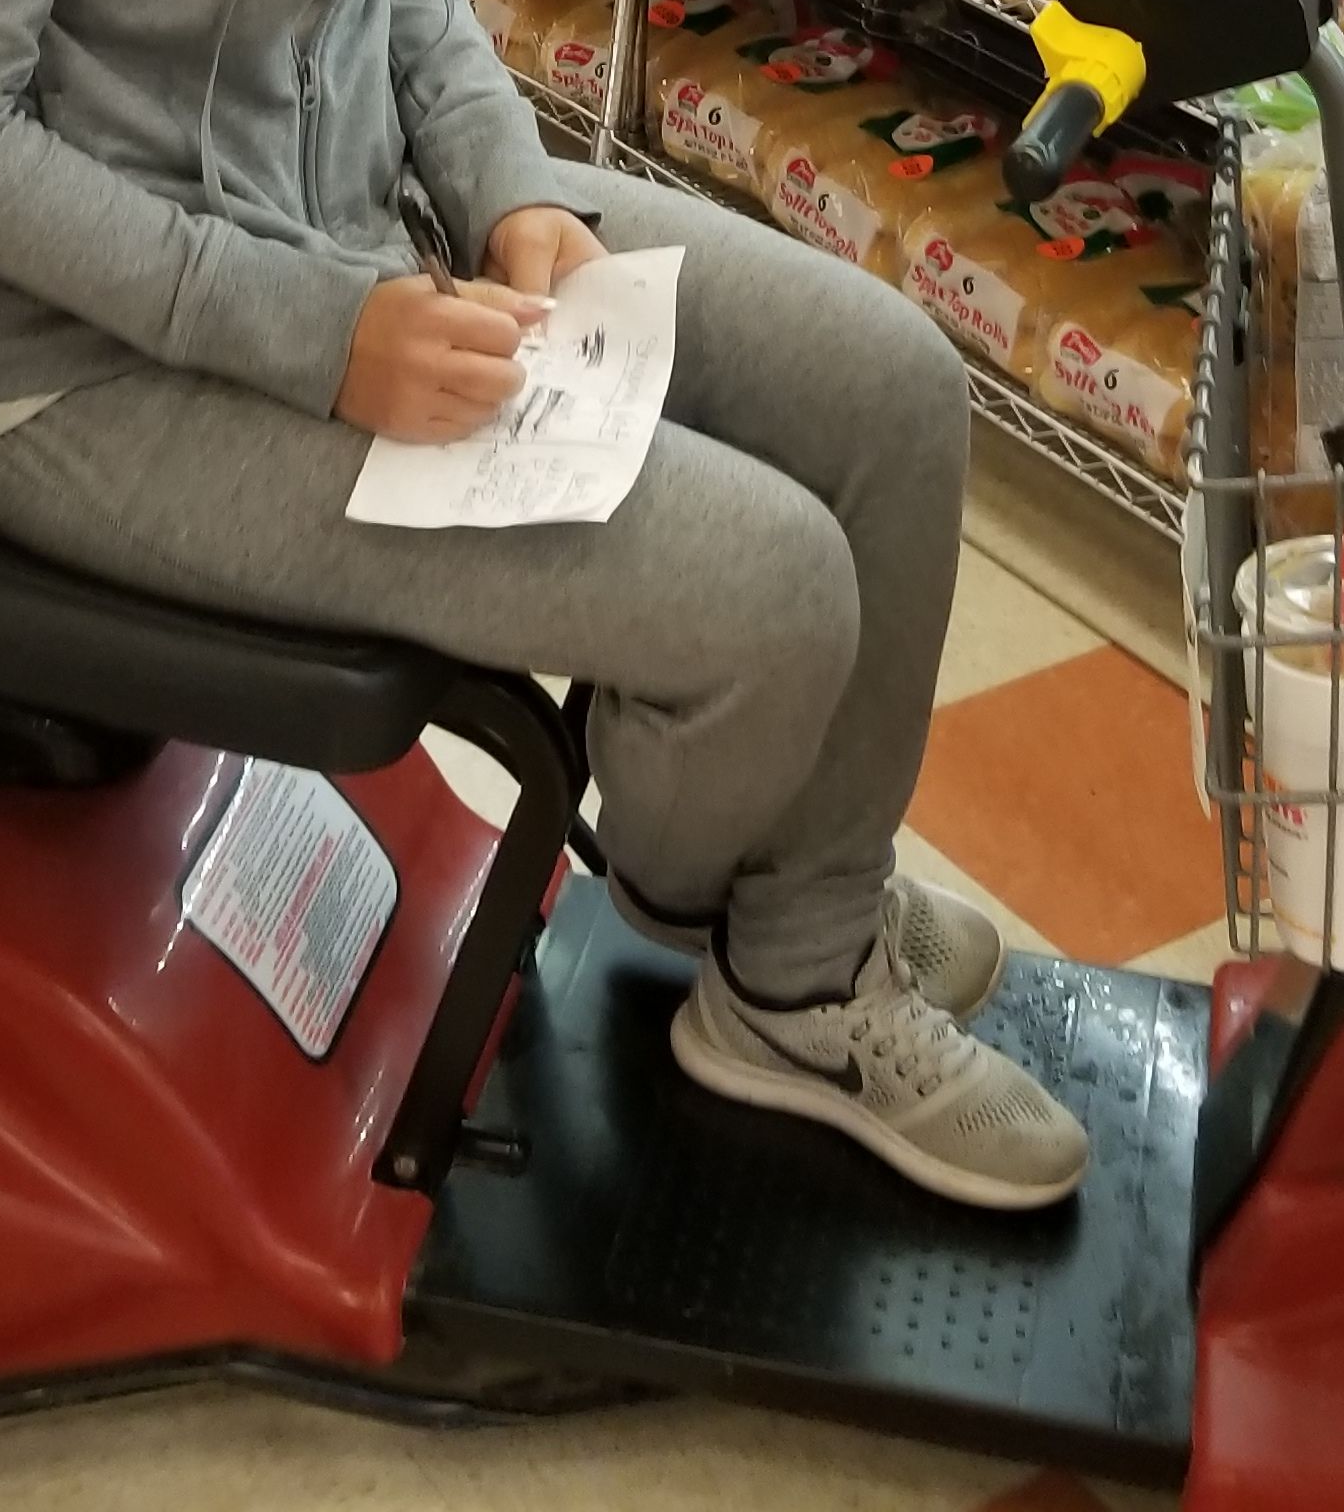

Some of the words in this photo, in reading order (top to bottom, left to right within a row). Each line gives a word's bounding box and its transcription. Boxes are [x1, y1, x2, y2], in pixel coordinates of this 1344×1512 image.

[595, 62, 608, 79] 6
[708, 107, 722, 126] 6
[699, 124, 728, 150] Top
[818, 193, 830, 213] 6
[962, 276, 975, 296] 6
[912, 265, 946, 301] Split
[946, 291, 970, 319] Top
[972, 310, 1009, 350] Rolls
[1104, 368, 1120, 390] 6
